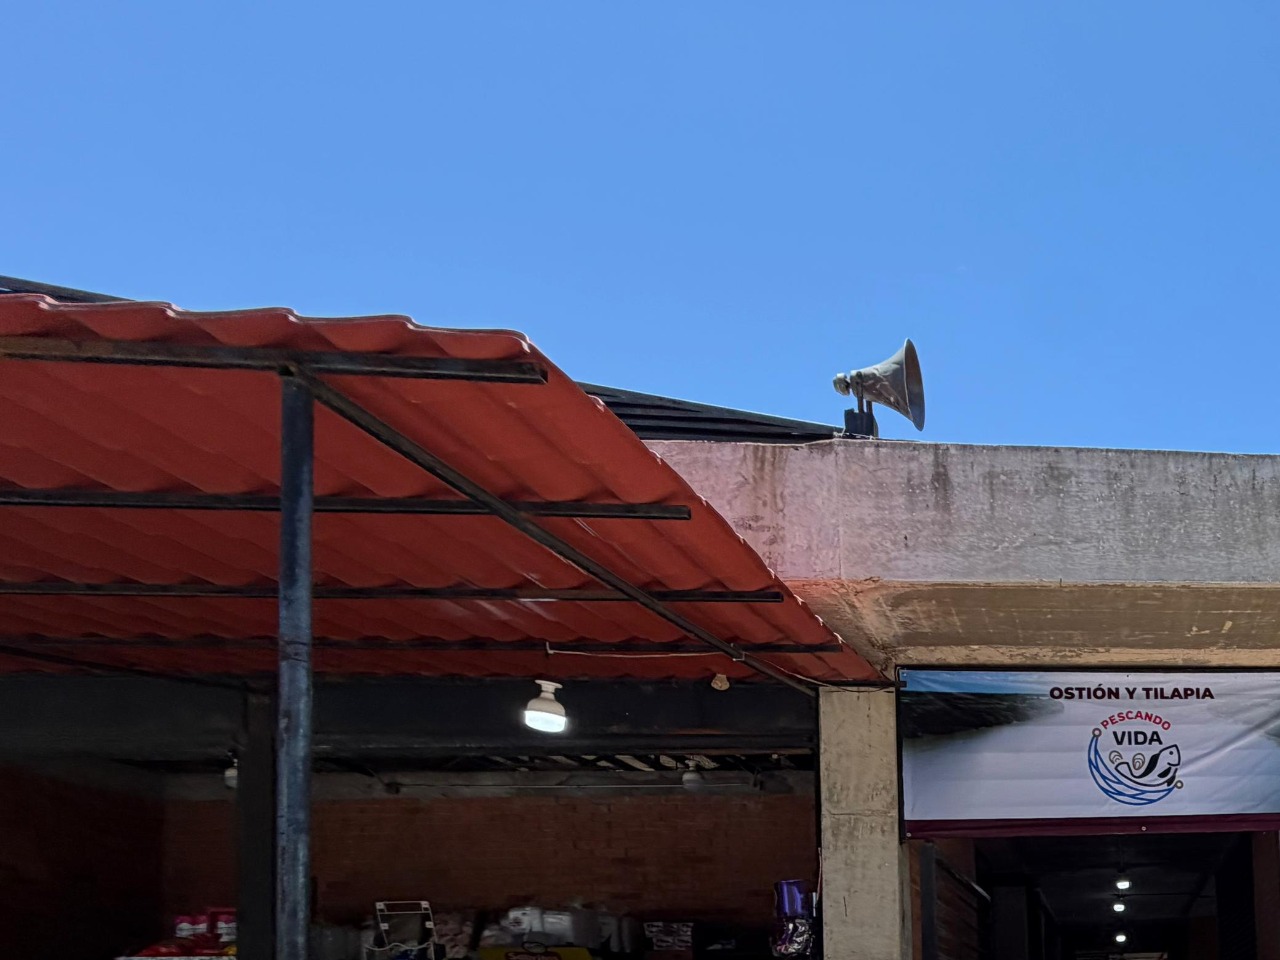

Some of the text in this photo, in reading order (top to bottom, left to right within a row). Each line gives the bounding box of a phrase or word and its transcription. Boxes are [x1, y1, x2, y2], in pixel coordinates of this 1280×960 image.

[1049, 684, 1215, 700] OSTIÓN Y TILAPIA
[1100, 710, 1171, 731] PESCANDO
[1112, 730, 1163, 746] VIDA
